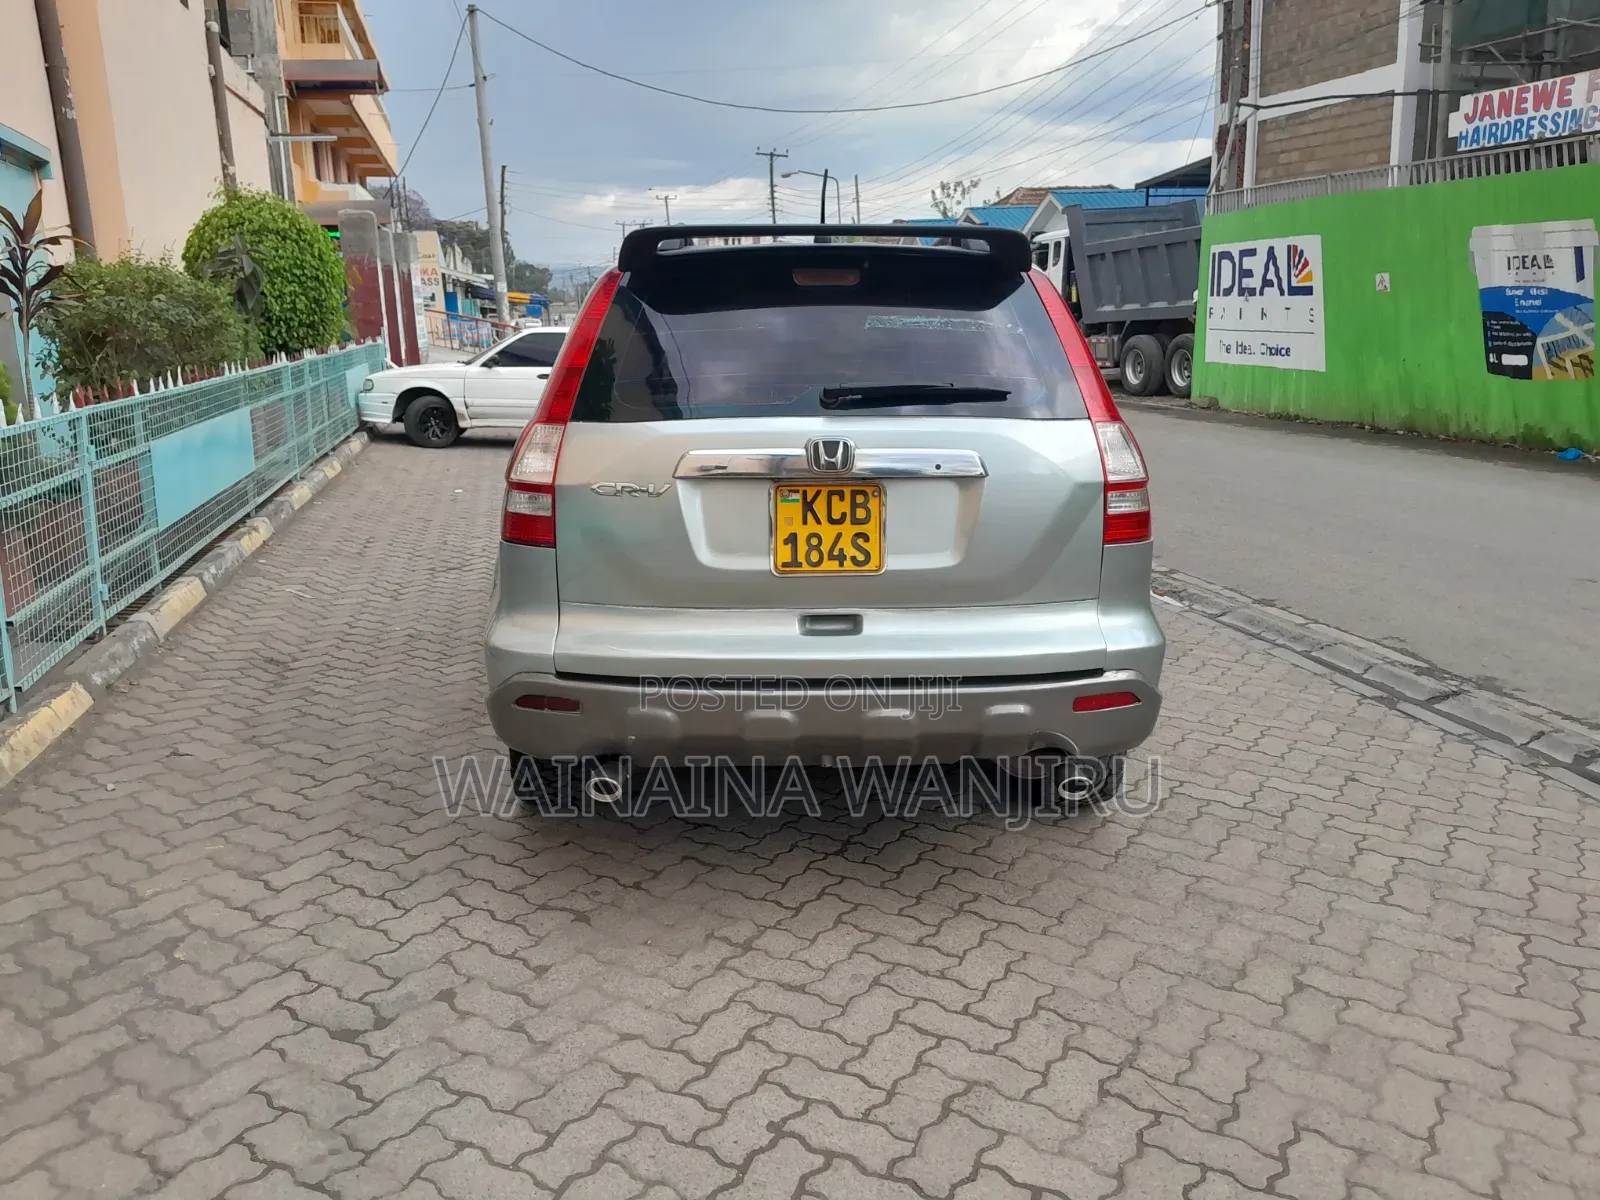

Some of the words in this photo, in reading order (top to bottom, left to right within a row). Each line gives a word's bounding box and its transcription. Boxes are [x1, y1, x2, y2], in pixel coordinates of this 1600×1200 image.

[1464, 76, 1576, 124] JANEWE
[1457, 105, 1598, 149] HAIRDRESSING
[1210, 244, 1314, 297] IDEAL
[1507, 254, 1555, 271] IDEAL
[1235, 341, 1256, 355] Idea
[1260, 342, 1291, 357] Choice
[590, 481, 673, 498] CR-V
[801, 489, 872, 526] KCB
[782, 532, 872, 568] 184S
